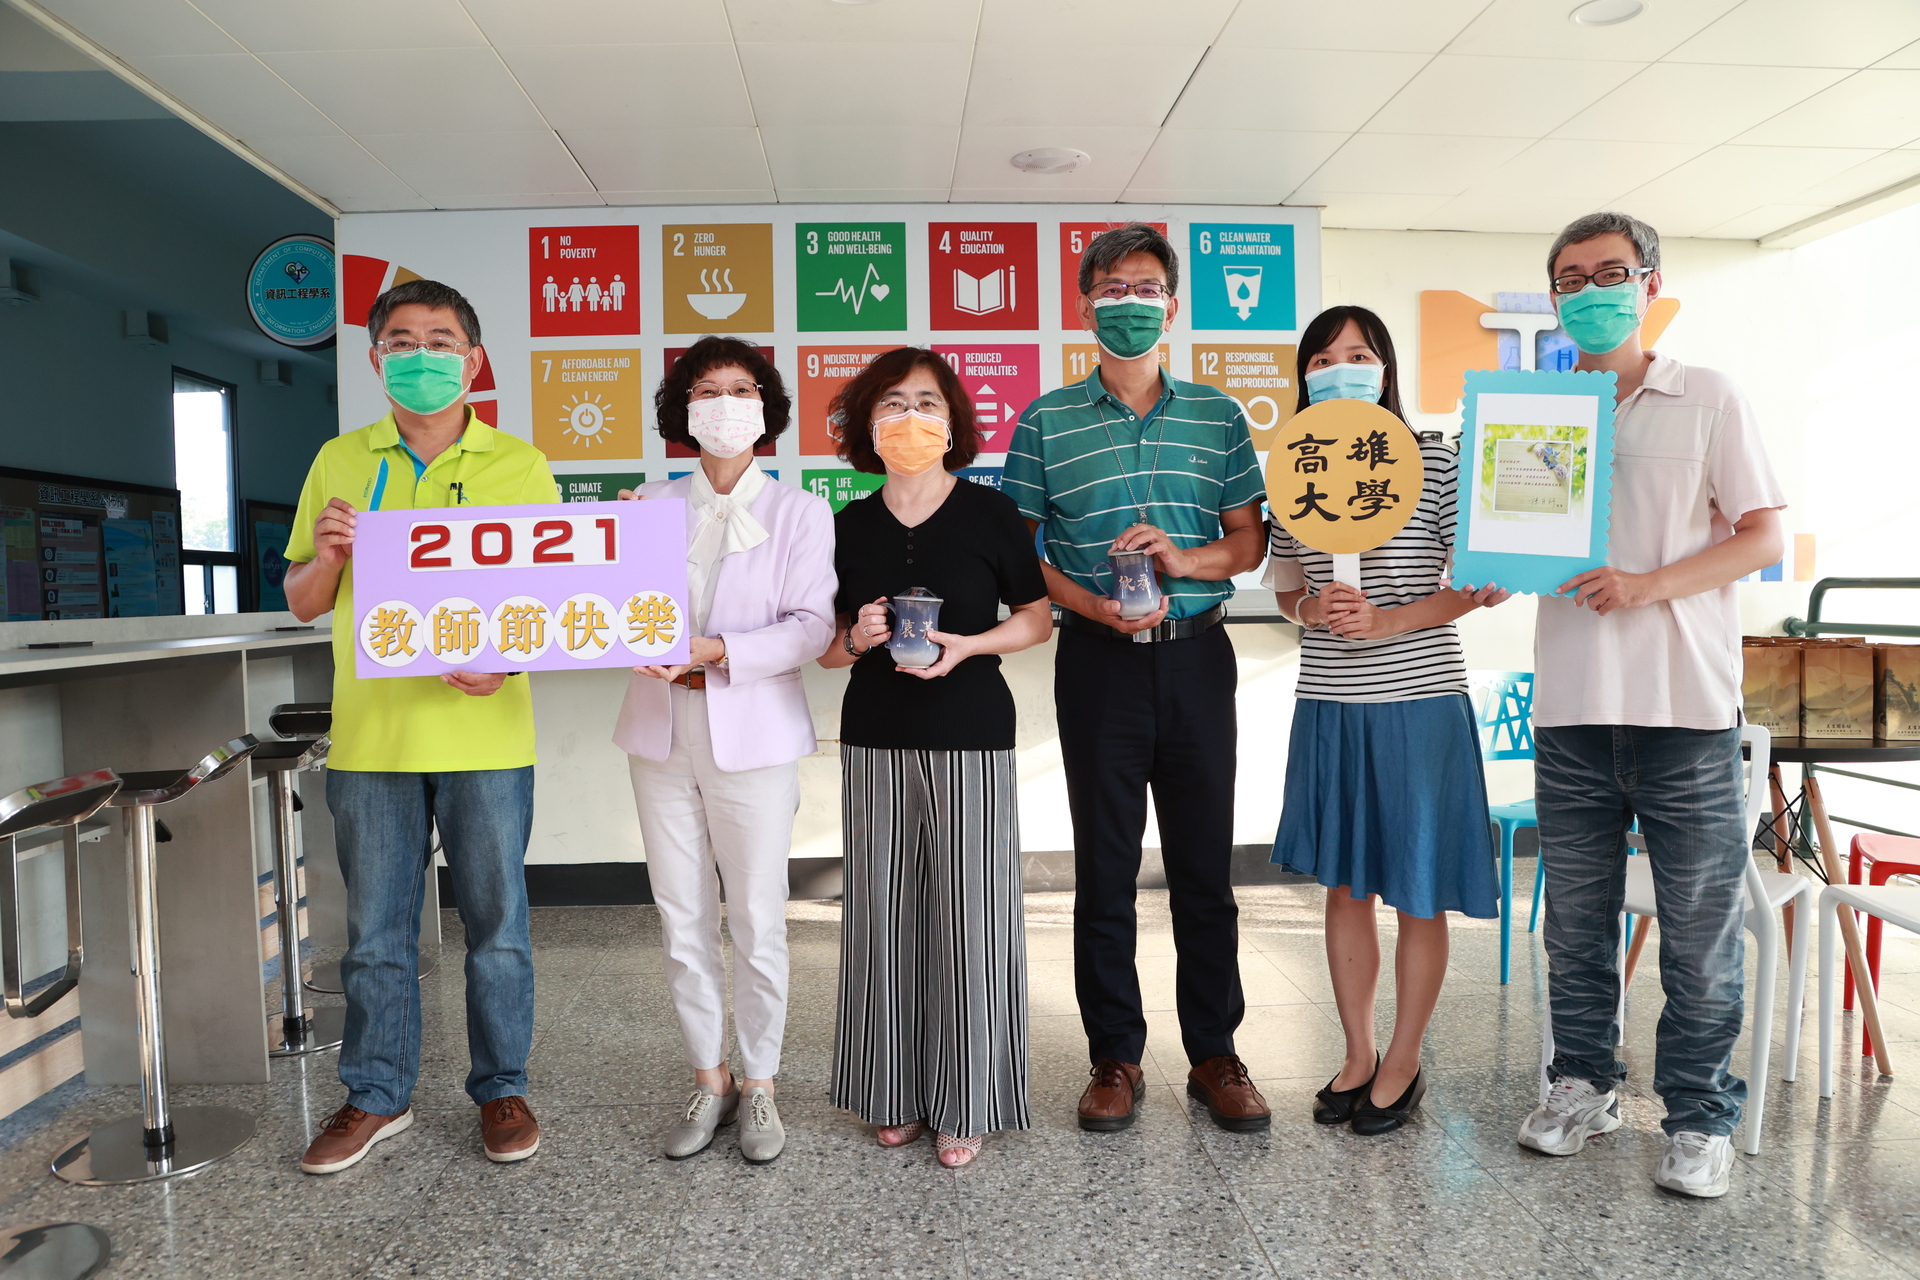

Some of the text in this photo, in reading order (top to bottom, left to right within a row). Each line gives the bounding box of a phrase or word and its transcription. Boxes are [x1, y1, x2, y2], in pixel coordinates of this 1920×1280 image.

[559, 235, 572, 246] NO
[693, 232, 715, 244] ZERO
[827, 230, 881, 242] GOOD HEALTH
[938, 230, 952, 254] 4
[960, 230, 994, 242] QUALITY
[1070, 230, 1083, 254] 5
[1219, 231, 1271, 243] CLEAN WATER
[541, 235, 549, 259] 1
[673, 232, 685, 257] 2
[806, 230, 819, 255] 3
[1199, 231, 1212, 255] 6
[559, 247, 597, 259] POVERTY
[693, 245, 727, 257] HUNGER
[827, 243, 892, 255] AND WELL-BEING
[960, 243, 1005, 255] EDUCATION
[1219, 244, 1282, 256] AND SANITATION
[255, 251, 281, 286] DEPARTMENT
[283, 246, 292, 254] OF
[294, 245, 328, 261] COMPUTER
[265, 287, 331, 300] 資訊工程學系
[256, 303, 266, 316] AND
[266, 316, 306, 334] INFORMATION
[561, 357, 631, 369] AFFORDABLE AND
[823, 354, 861, 365] INDUSTRY,
[965, 352, 1002, 363] REDUCED
[1069, 352, 1086, 375] 11
[1199, 351, 1219, 376] 12
[1225, 352, 1275, 363] RESPONSIBLE
[541, 359, 552, 383] 7
[806, 353, 820, 378] 9
[965, 365, 1018, 377] INEQUALITIES
[1225, 364, 1279, 376] CONSUMPTION
[561, 370, 619, 383] CLEAN ENERGY
[823, 367, 840, 378] AND
[1225, 377, 1290, 388] AND PRODUCTION
[1287, 429, 1399, 474] 高雄
[569, 482, 603, 493] CLIMATE
[809, 477, 830, 500] 15
[836, 477, 852, 488] LIFE
[836, 489, 872, 501] ON LAND
[1289, 478, 1400, 522] 大學
[411, 518, 616, 568] 2021
[368, 594, 677, 658] 教師節快樂
